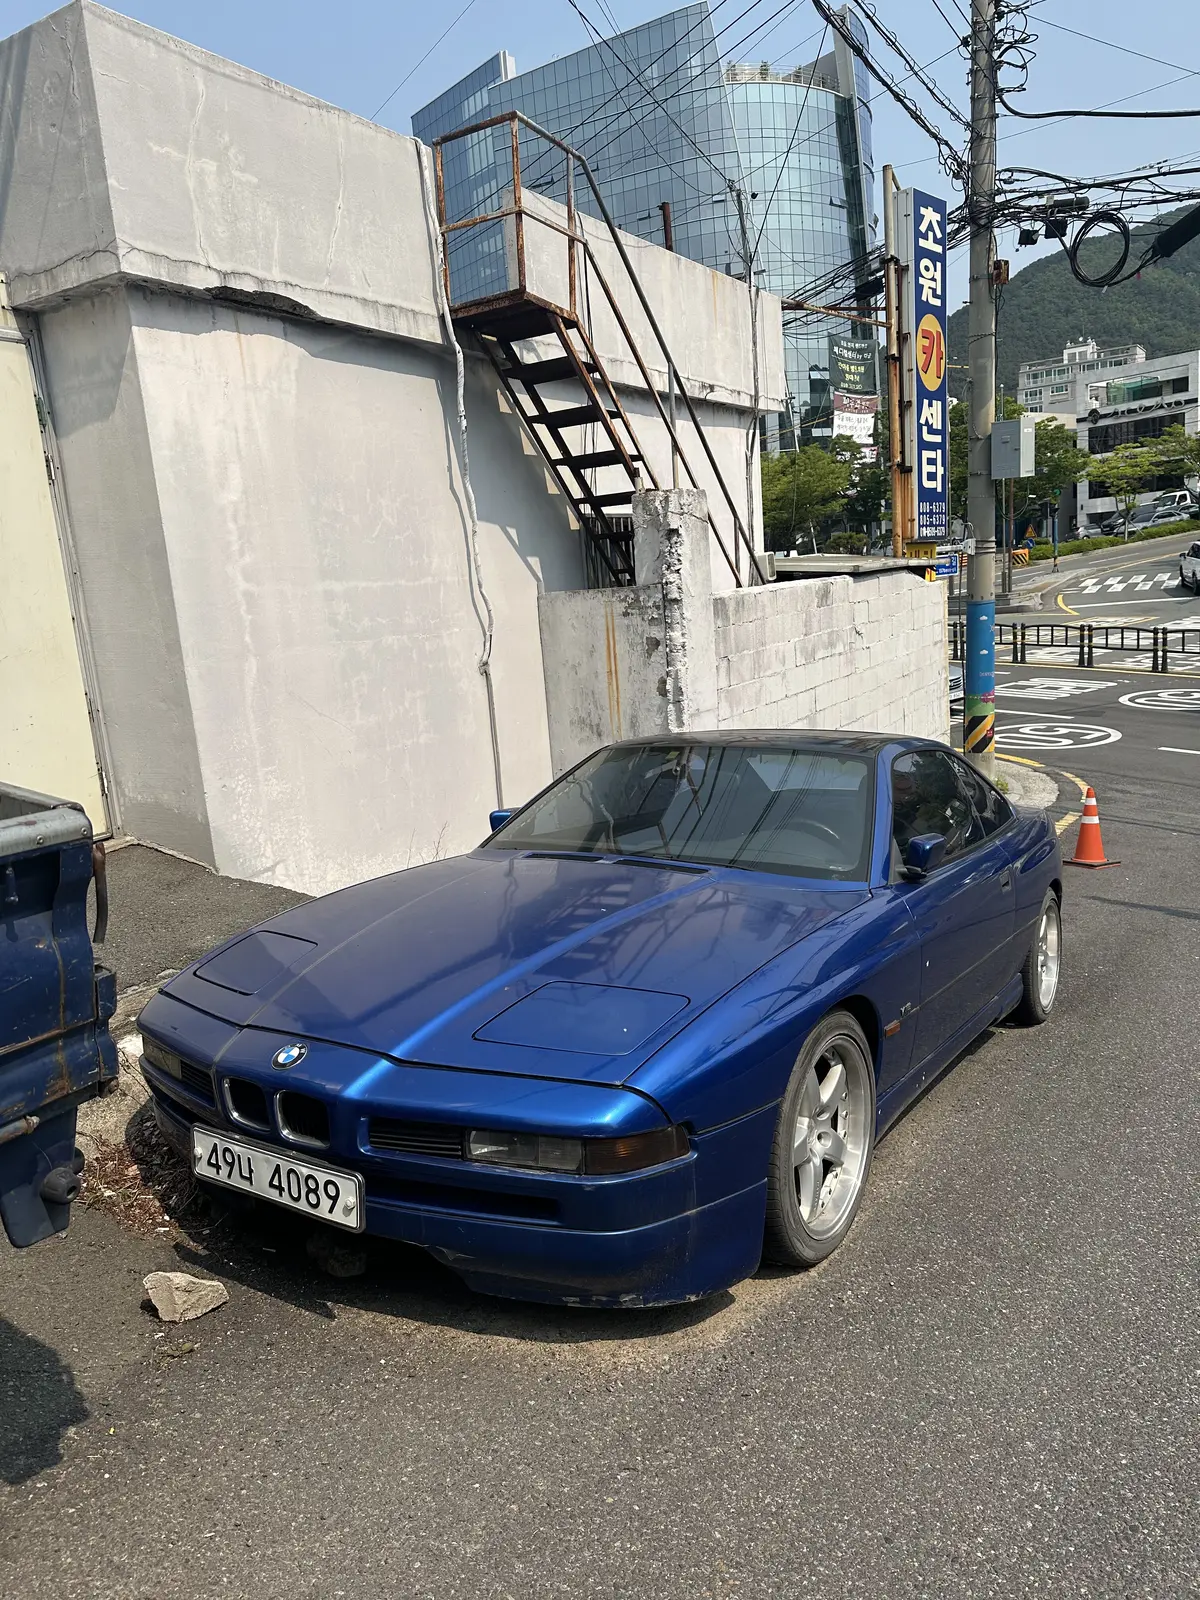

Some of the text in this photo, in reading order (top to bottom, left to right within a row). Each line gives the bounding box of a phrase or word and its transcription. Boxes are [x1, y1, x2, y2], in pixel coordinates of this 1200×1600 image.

[919, 514, 945, 525] 805-6379
[206, 1142, 341, 1215] 49나 4089
